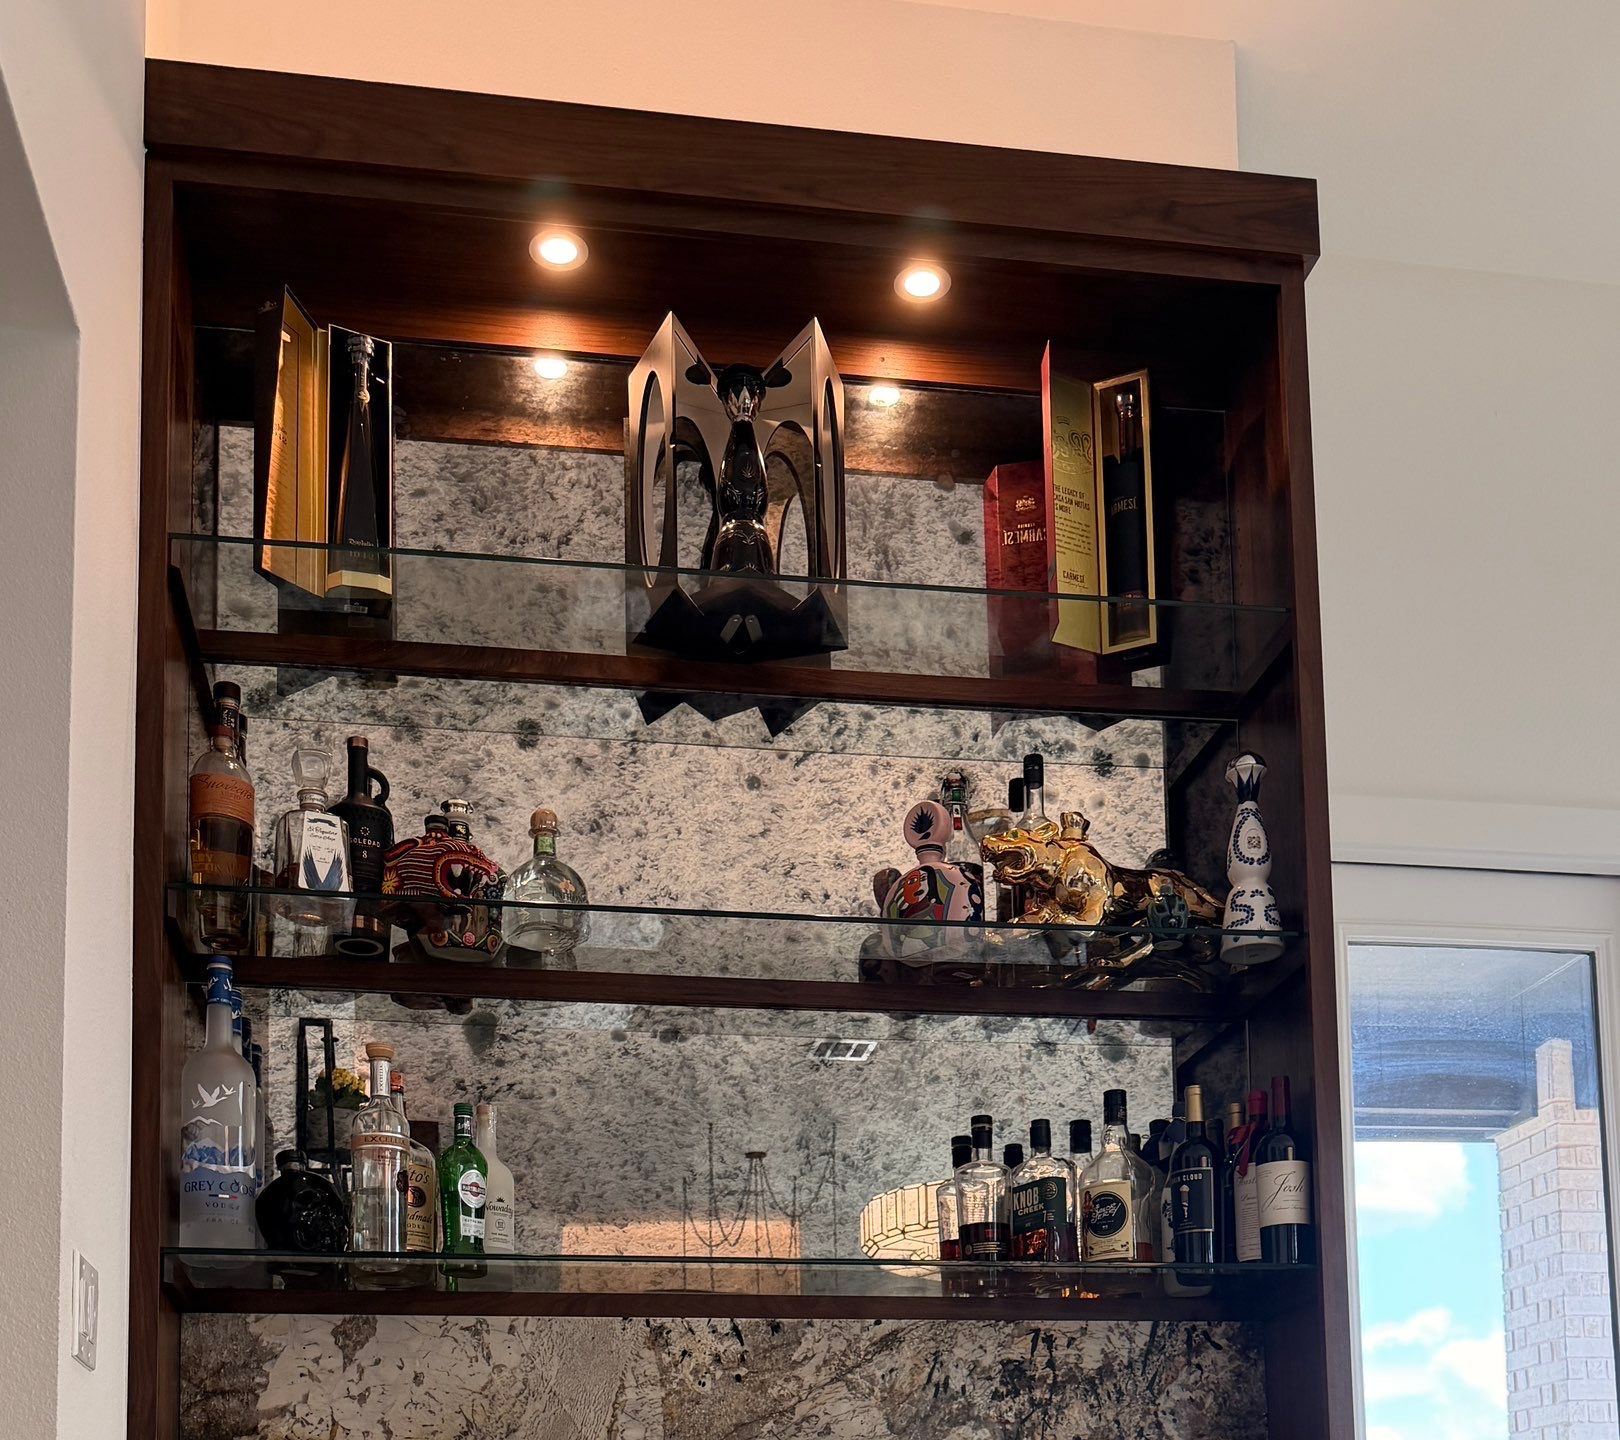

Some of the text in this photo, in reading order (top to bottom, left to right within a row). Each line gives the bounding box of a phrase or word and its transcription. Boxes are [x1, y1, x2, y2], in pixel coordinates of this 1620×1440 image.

[1182, 1173, 1203, 1182] CLOUD
[184, 1180, 215, 1193] GREY
[1261, 1171, 1305, 1213] Josh
[1013, 1187, 1039, 1211] KNOB
[1018, 1203, 1045, 1216] CREEK
